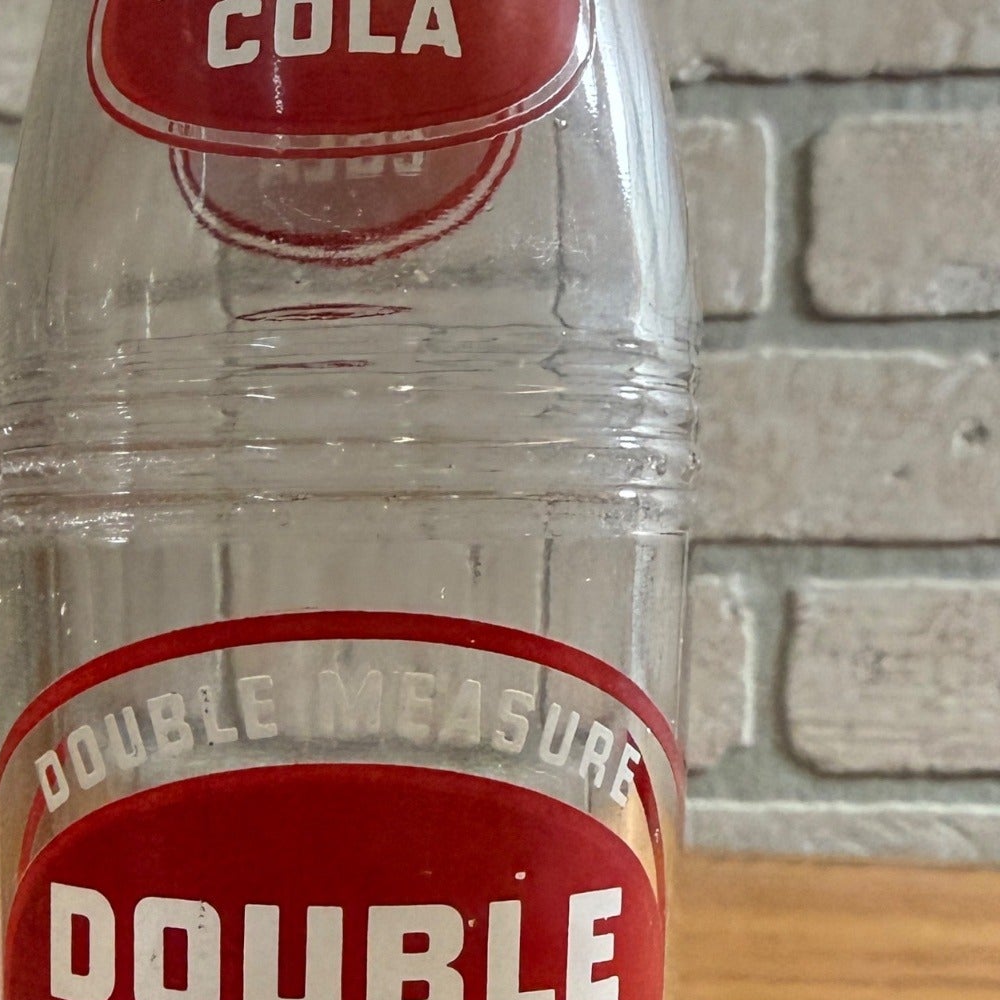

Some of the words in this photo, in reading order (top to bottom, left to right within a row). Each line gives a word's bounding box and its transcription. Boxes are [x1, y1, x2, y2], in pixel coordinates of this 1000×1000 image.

[207, 0, 462, 69] COLA
[35, 674, 278, 813] DOUBLE
[317, 668, 641, 807] MEASURE
